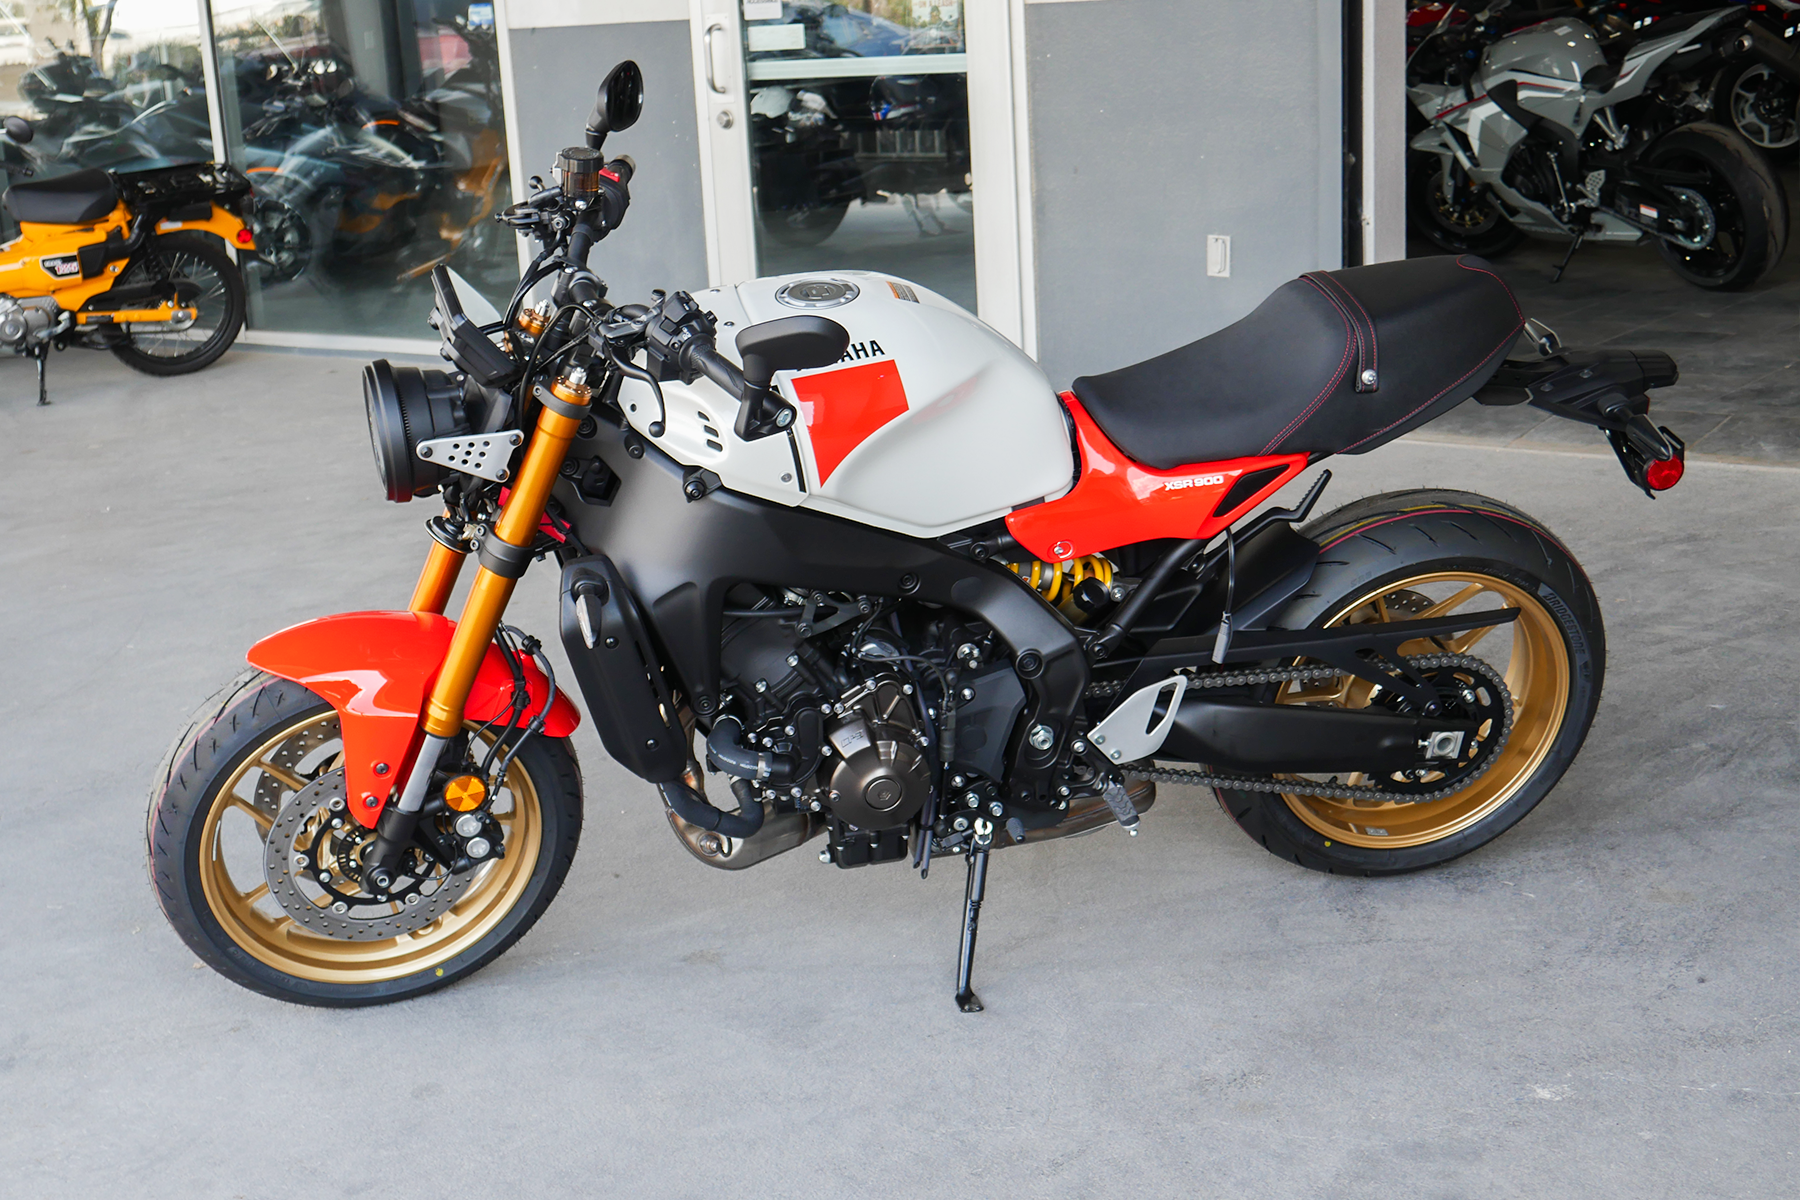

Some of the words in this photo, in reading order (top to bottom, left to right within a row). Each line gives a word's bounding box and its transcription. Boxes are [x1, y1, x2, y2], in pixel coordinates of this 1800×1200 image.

[841, 339, 886, 363] AHA
[1164, 479, 1194, 491] XSR
[1194, 475, 1224, 487] 900
[1542, 592, 1586, 655] BRIDGESTONE
